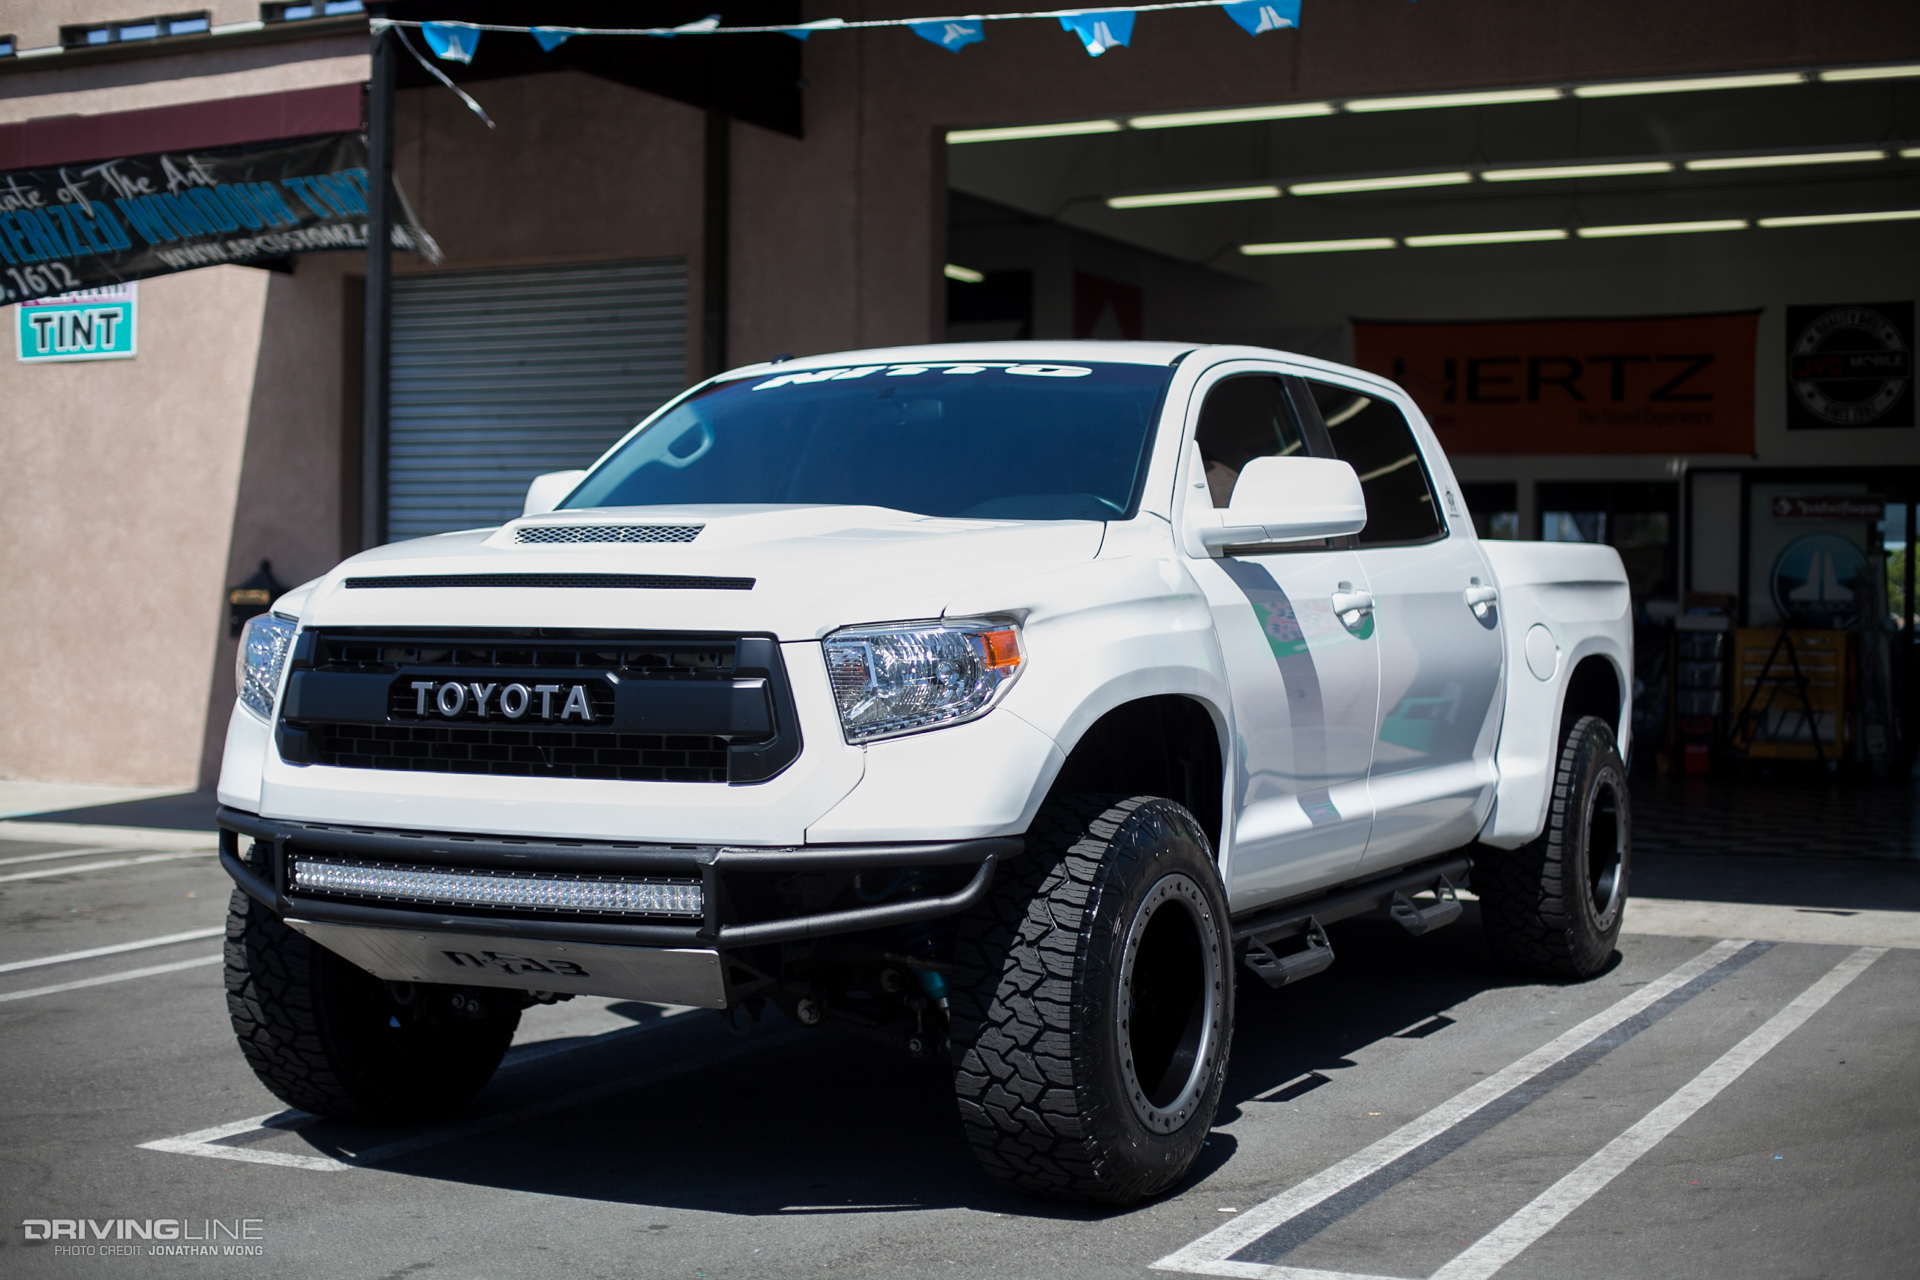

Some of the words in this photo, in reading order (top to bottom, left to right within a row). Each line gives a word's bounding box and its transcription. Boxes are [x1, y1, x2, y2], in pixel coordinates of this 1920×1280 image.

[0, 174, 48, 212] ate
[57, 167, 94, 219] of
[81, 157, 157, 200] The
[160, 154, 217, 198] Art
[114, 181, 300, 244] WINDOW
[29, 307, 123, 353] TINT
[752, 362, 1093, 391] NITTO
[1395, 353, 1715, 402] HERTZ
[1796, 357, 1843, 378] JVC
[411, 681, 594, 722] TOYOTA
